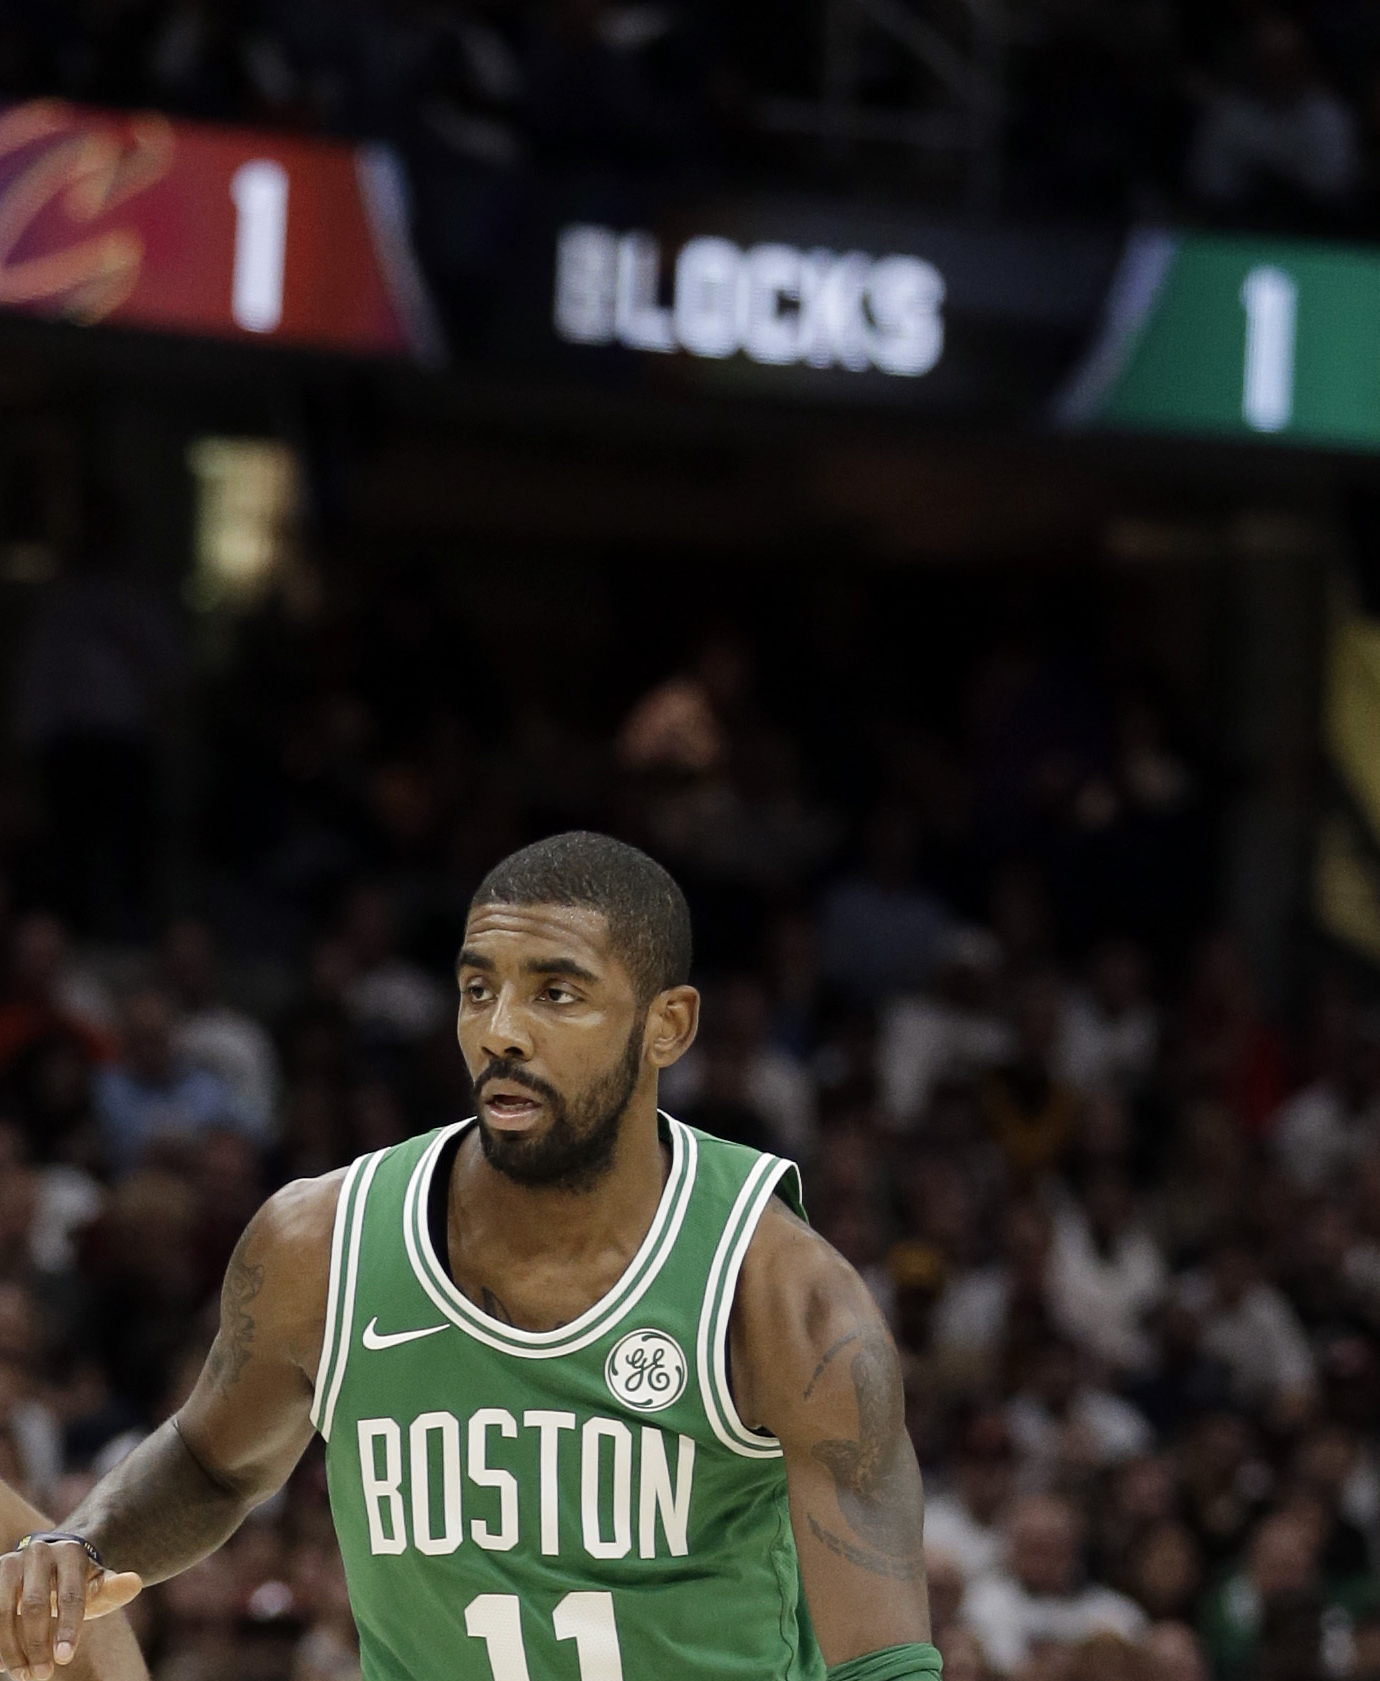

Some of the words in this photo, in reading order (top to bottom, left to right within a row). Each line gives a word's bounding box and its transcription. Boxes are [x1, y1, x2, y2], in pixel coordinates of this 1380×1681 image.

[555, 222, 946, 377] BLOCKS
[1241, 265, 1298, 433] 1
[356, 1408, 696, 1560] BOSTON
